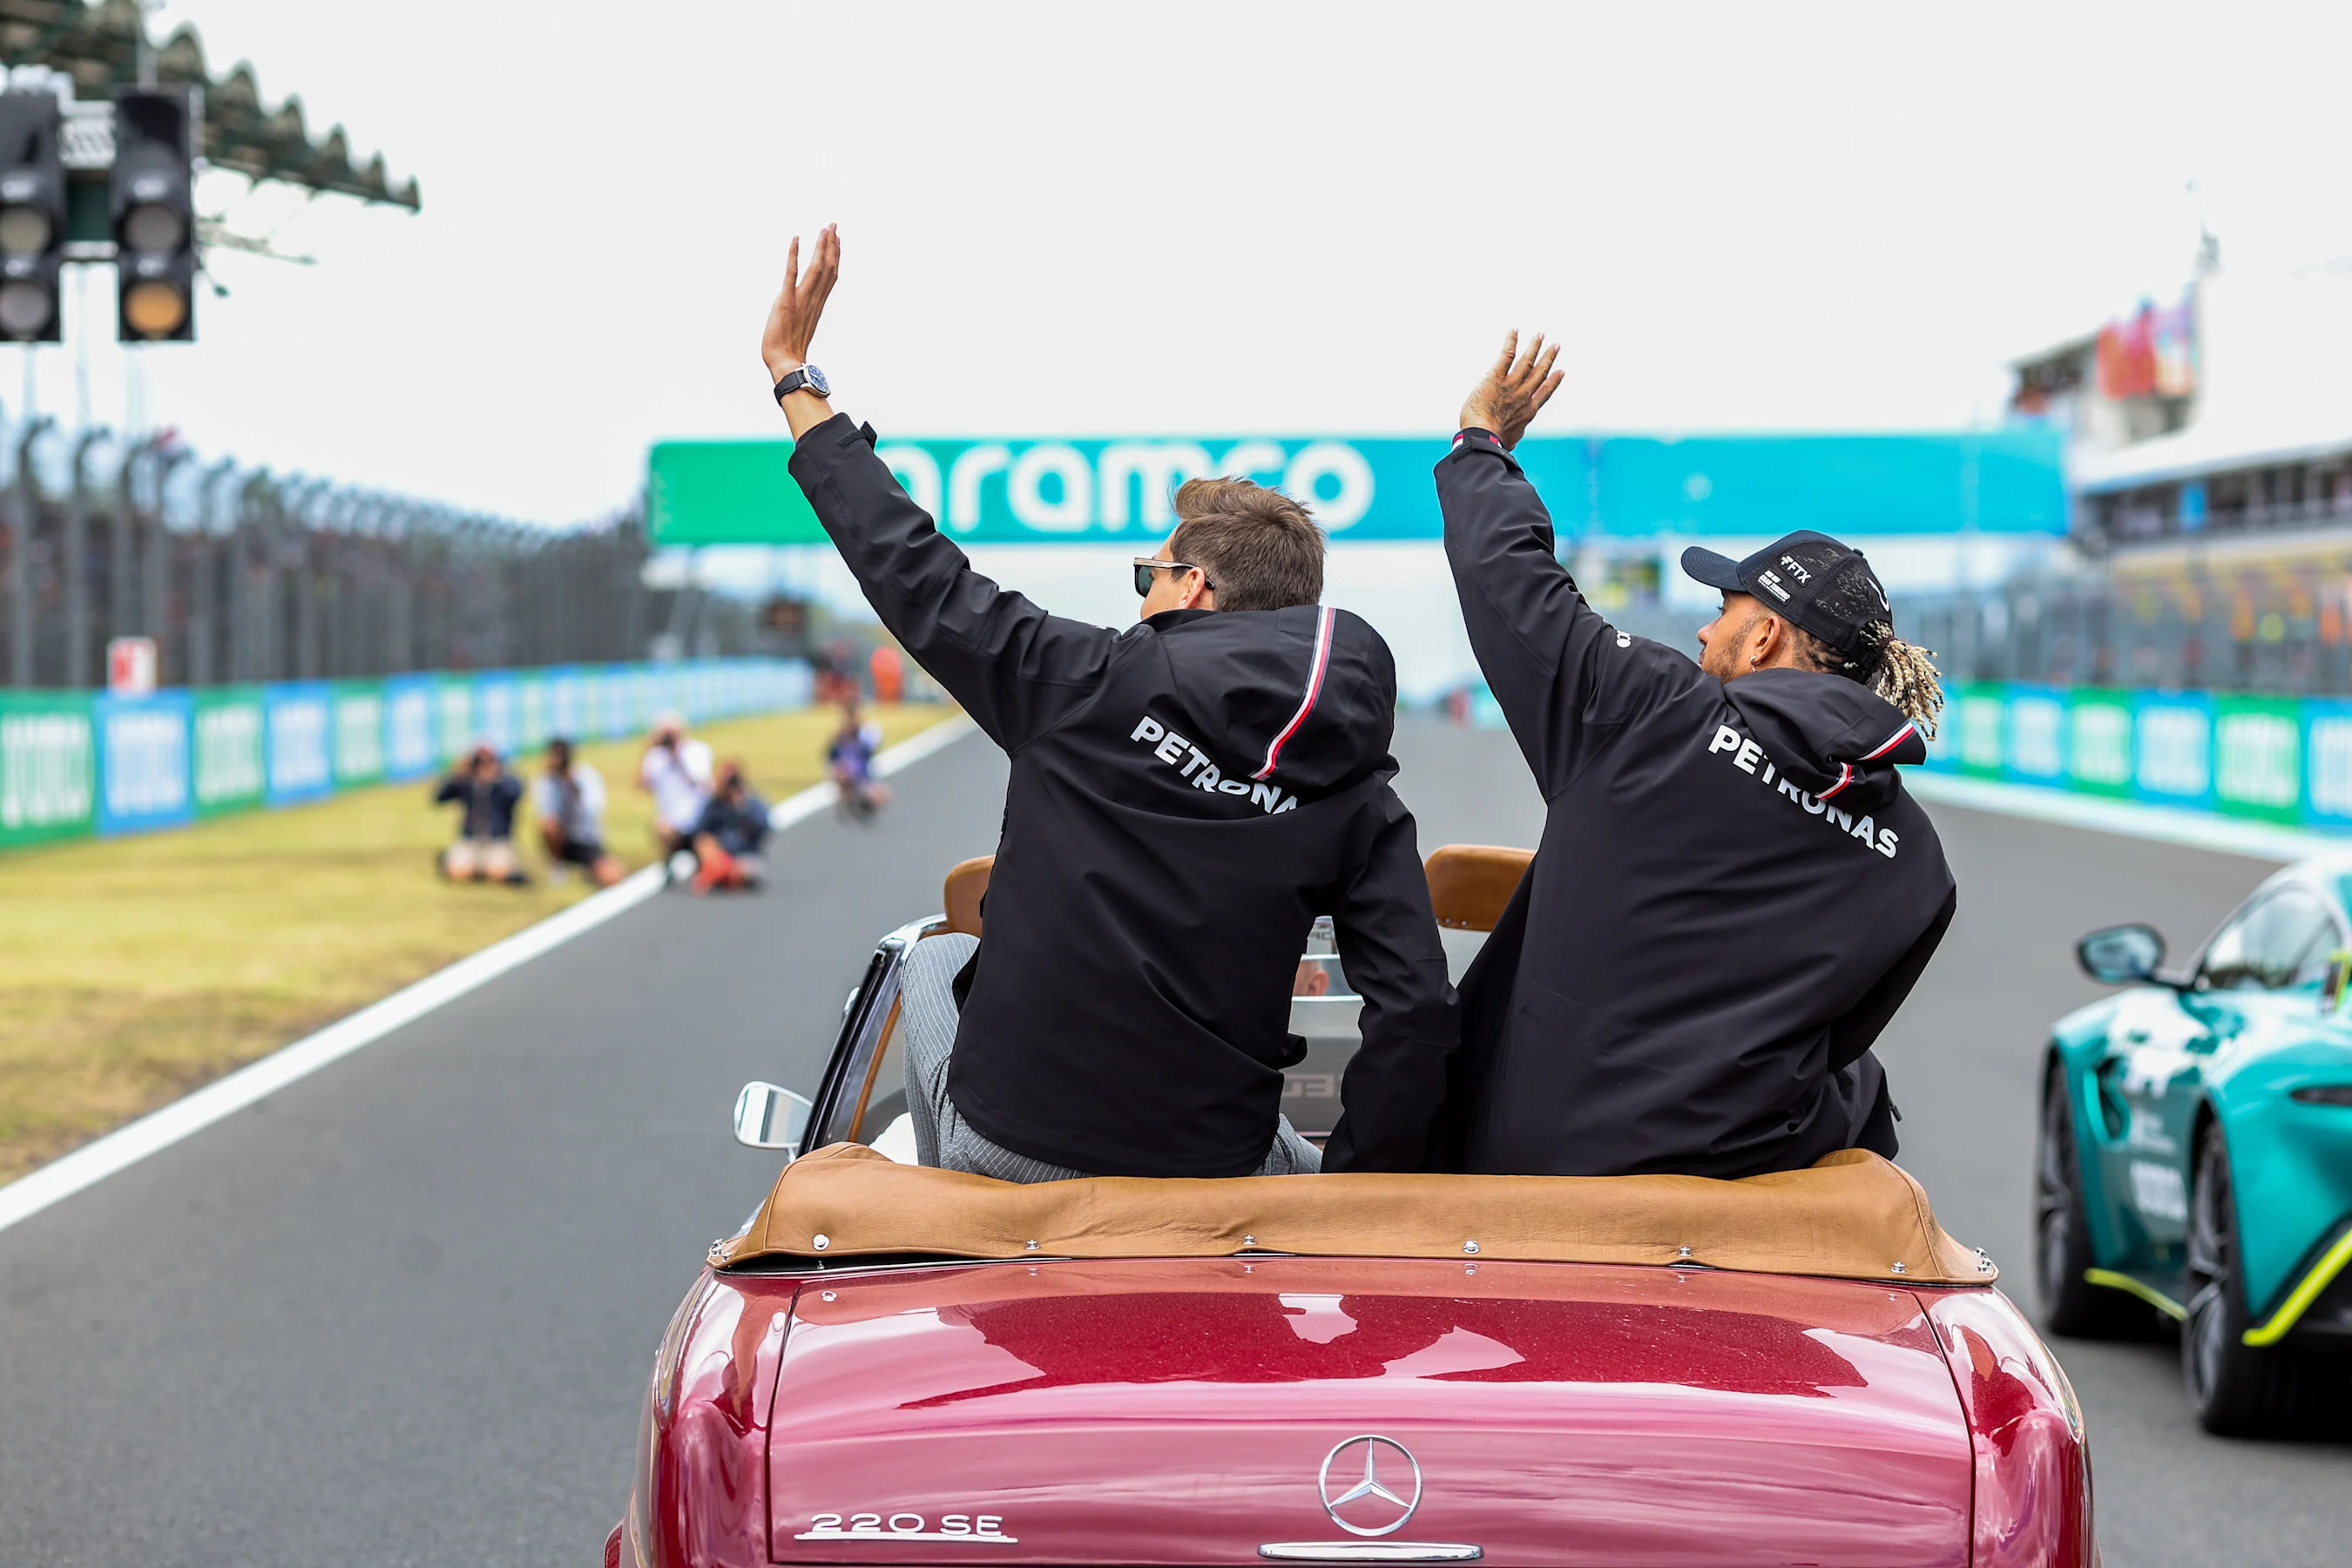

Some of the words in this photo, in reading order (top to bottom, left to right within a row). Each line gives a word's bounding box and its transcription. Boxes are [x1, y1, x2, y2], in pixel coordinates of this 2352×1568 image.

[1787, 561, 1812, 585] FTX
[811, 1512, 925, 1533] 220
[940, 1514, 1003, 1537] SE
